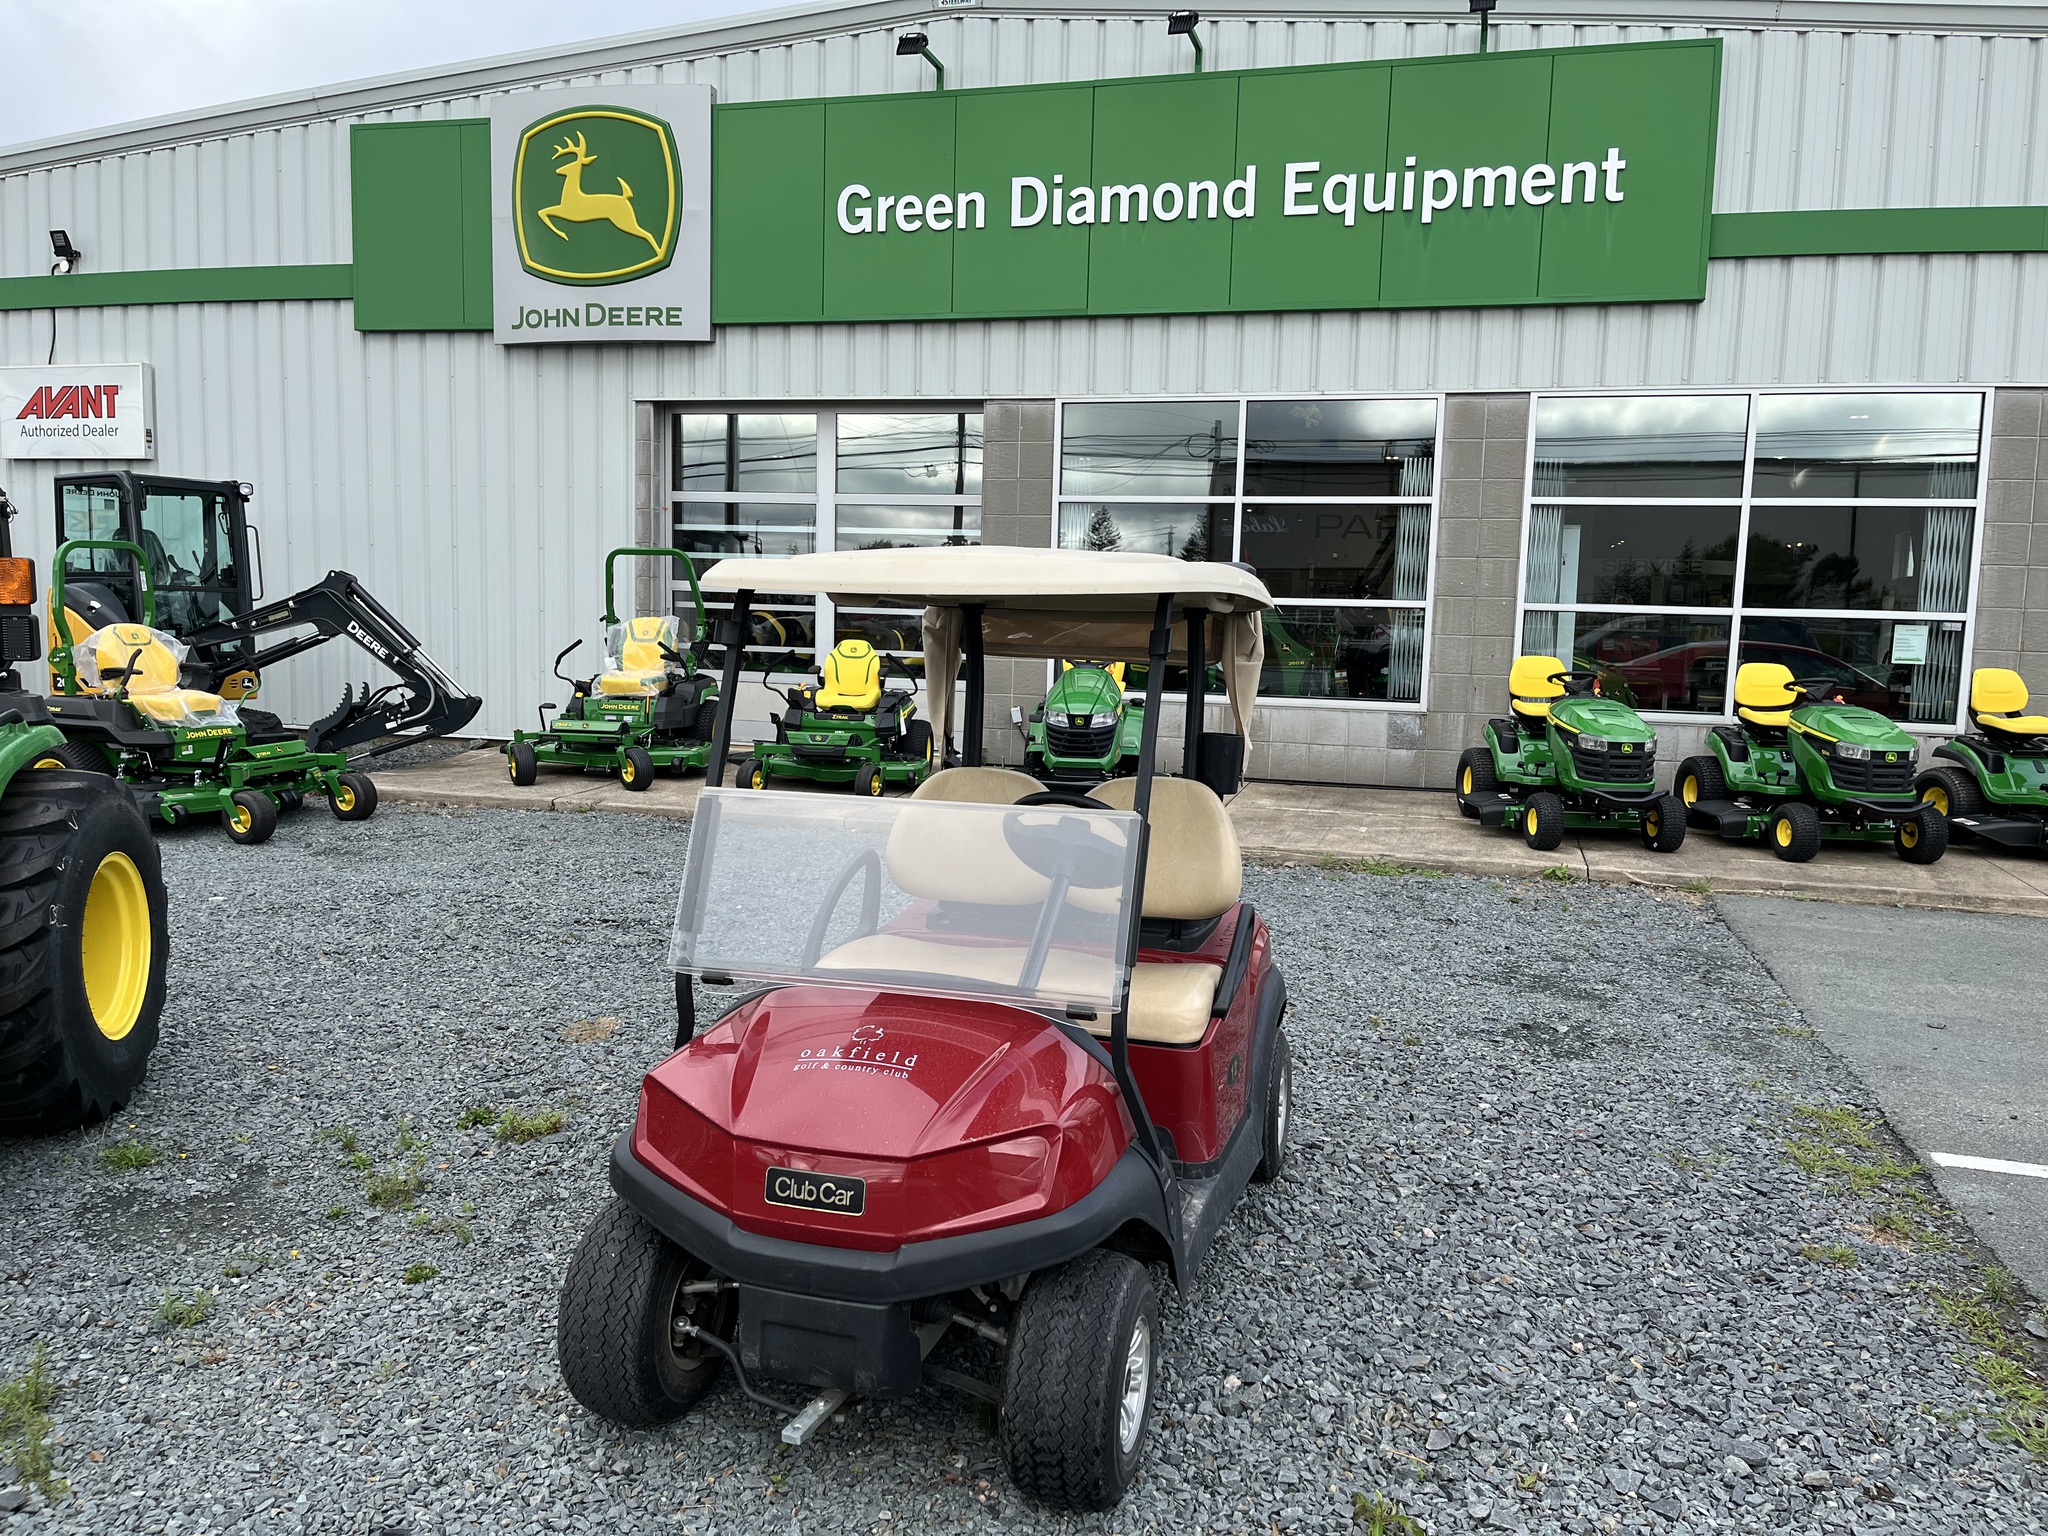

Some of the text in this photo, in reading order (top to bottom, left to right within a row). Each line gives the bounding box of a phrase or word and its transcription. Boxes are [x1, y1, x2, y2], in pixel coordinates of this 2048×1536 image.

[836, 147, 1627, 234] Green Diamond Equipment
[511, 303, 683, 330] JOHN DEERE
[15, 384, 119, 420] AVANT
[20, 423, 119, 438] Authorized Dealer
[346, 620, 389, 660] DEERE
[186, 728, 233, 740] JOHN DEERE
[800, 1045, 918, 1067] oakfield
[792, 1061, 909, 1079] golf & country club
[775, 1176, 855, 1206] Club Car
